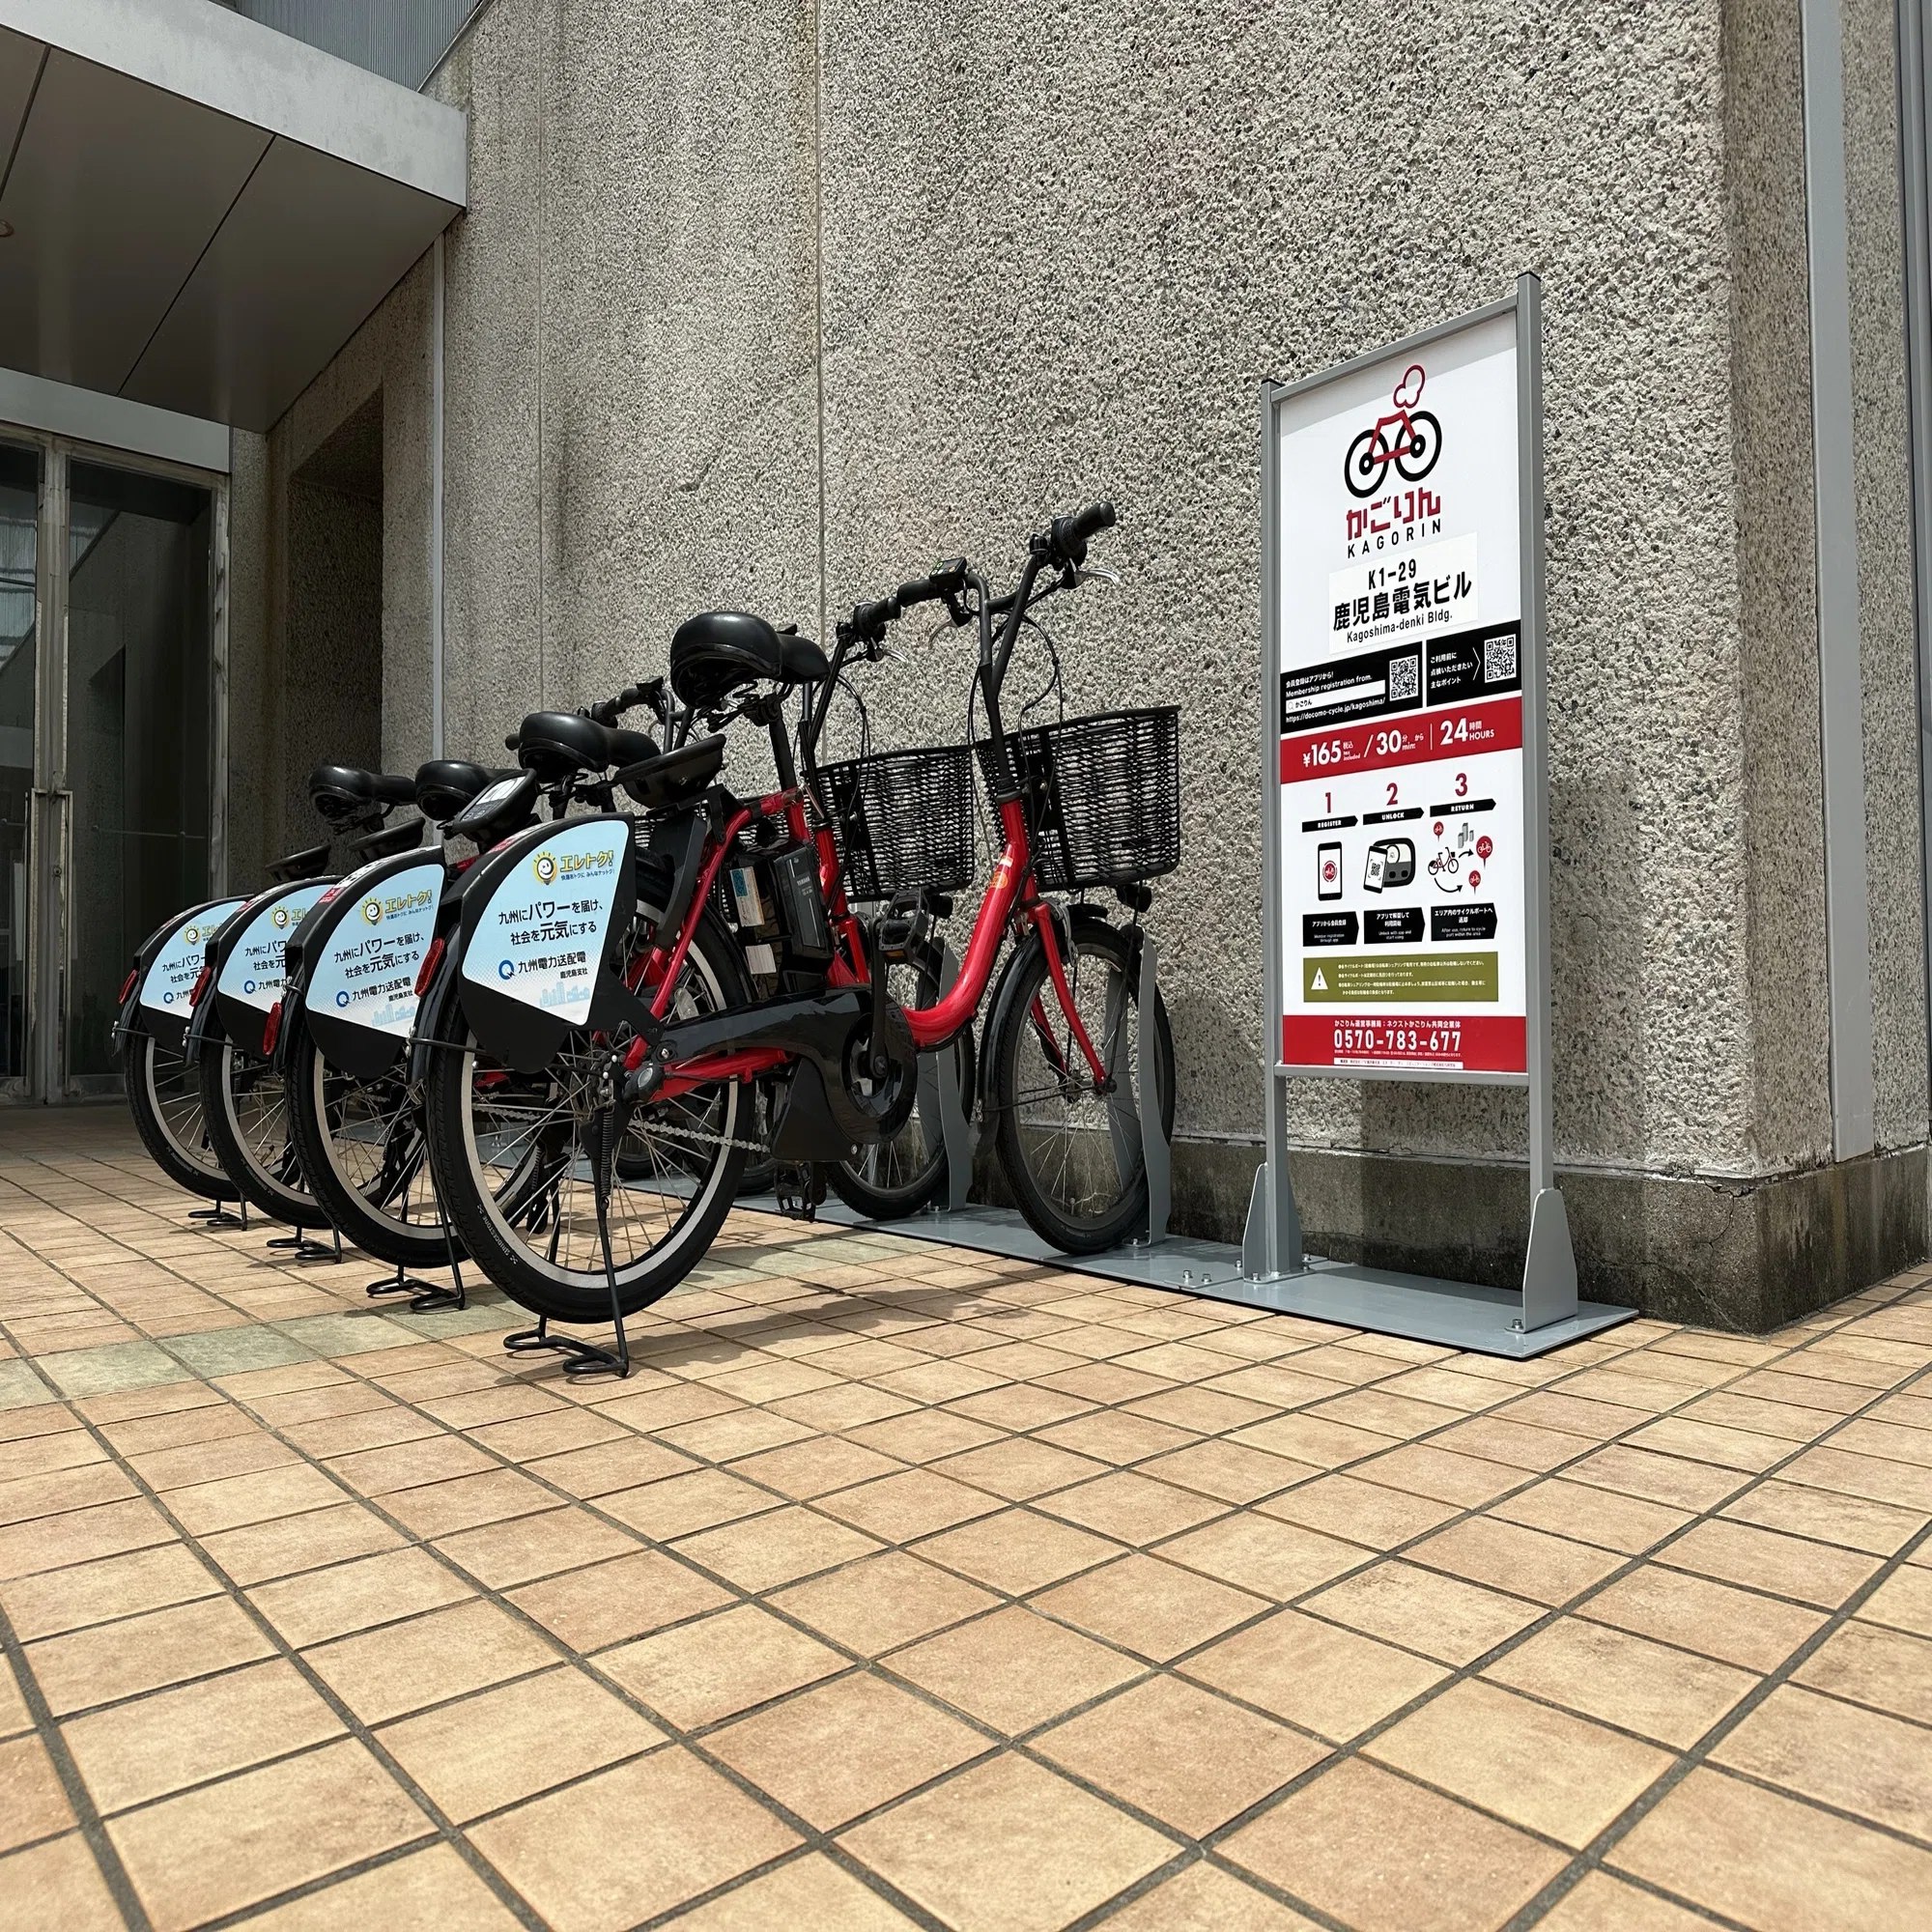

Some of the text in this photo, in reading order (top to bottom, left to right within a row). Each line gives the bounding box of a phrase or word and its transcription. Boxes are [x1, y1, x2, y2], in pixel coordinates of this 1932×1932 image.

[1347, 487, 1441, 541] かごりん
[1348, 519, 1441, 559] KAGORIN
[1369, 558, 1417, 590] K1-29
[1333, 571, 1472, 632] 鹿児島電気ビル
[1347, 609, 1453, 643] Kagoshima-denki Bldg.
[1286, 684, 1320, 697] Membership
[1321, 677, 1355, 692] registration
[1430, 676, 1462, 689] 主なポイント
[1440, 718, 1468, 746] 24
[1468, 729, 1494, 741] HOURS
[1386, 782, 1398, 806] 2
[1455, 773, 1468, 797] 3
[1324, 792, 1331, 813] 1
[1451, 804, 1475, 812] RETURN
[1318, 820, 1342, 829] REGISTER
[1381, 812, 1405, 821] UNLOCK
[559, 849, 614, 872] エレトク!
[498, 898, 603, 924] 九州にパワーを届け、
[510, 921, 597, 946] 社会を元気にする
[334, 931, 424, 963] 九州にパワーを届け、
[345, 951, 420, 980] 社会を元気にする
[518, 951, 586, 974] 九州電力送配電
[559, 968, 588, 979] 鹿児島支社
[353, 977, 412, 1002] 九州電力送配電
[1334, 1029, 1462, 1052] 0570-783-677
